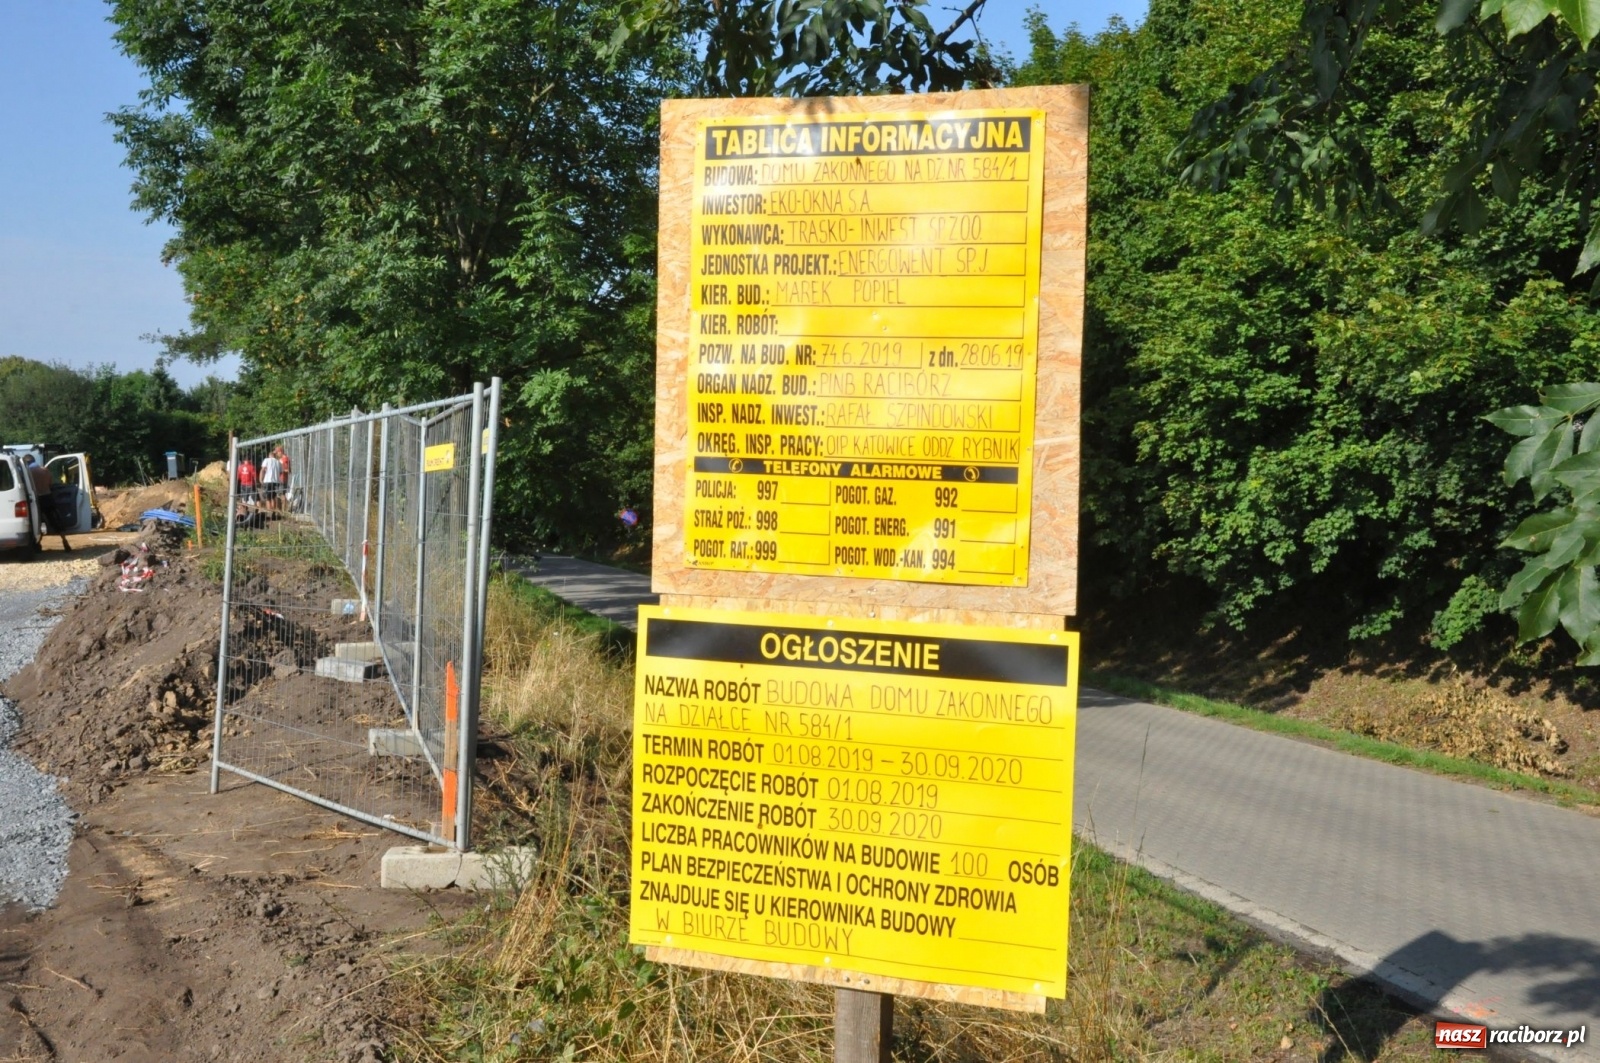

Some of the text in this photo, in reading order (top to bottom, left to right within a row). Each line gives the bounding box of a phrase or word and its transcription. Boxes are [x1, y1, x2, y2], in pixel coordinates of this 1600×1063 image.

[712, 121, 1024, 156] TABLICA INFORMACYJNA
[704, 165, 758, 187] BUDOWA:
[761, 162, 805, 183] DOMU
[813, 159, 896, 183] ZAKONNEGO
[904, 159, 923, 181] NA
[948, 158, 967, 180] NR
[972, 155, 1018, 181] 584/1
[702, 193, 767, 216] INWESTOR:
[770, 189, 844, 214] EKO-OKNA
[702, 223, 784, 246] WYKONAWCA:
[701, 254, 768, 276] JEDNOSTKA
[773, 254, 837, 276] PROJEKT.:
[838, 247, 946, 275] ENERGOWENT
[701, 284, 732, 306] KIER.
[775, 280, 832, 304] MAREK
[853, 278, 906, 304] POPIEL
[700, 308, 779, 336] KIER. ROBÓT:
[699, 343, 735, 365] POZW.
[740, 344, 756, 365] NA
[760, 344, 789, 365] BUD.
[795, 344, 816, 366] NR:
[928, 350, 936, 368] z
[939, 345, 958, 368] dn.
[697, 372, 737, 395] ORGAN
[741, 373, 776, 395] NADZ.
[820, 372, 856, 395] PINB
[863, 369, 952, 396] RACIBÓRZ
[697, 402, 726, 424] INSP.
[731, 403, 766, 425] NADZ.
[826, 402, 876, 426] RAFAŁ
[886, 402, 992, 429] SZPINDOWSKI
[697, 432, 740, 457] OKRĘG.
[745, 433, 775, 455] INSP.
[780, 434, 824, 457] PRACY:
[826, 434, 849, 456] OIP
[853, 434, 916, 457] KATOWICE
[962, 436, 1019, 460] RYBNIK
[763, 460, 942, 480] TELEFONY ALARMOWE
[695, 479, 779, 501] POLICJA: 997
[835, 485, 958, 508] POGOT. GAZ. 992
[694, 505, 723, 529] STRAŻ
[756, 510, 778, 531] 998
[835, 515, 956, 539] POGOT. ENERG. 991
[694, 538, 726, 558] POGOT.
[755, 540, 777, 561] 999
[834, 546, 955, 570] POGOT. WOD.-KAN. 994
[760, 632, 940, 671] OGŁOSZENIE
[644, 674, 1053, 725] NAZWA ROBÓT BUDOWA DOMU ZAKONNEGO
[645, 702, 853, 741] NA DZIAŁCE NR 584/1
[642, 734, 703, 759] TERMIN
[708, 738, 765, 764] ROBÓT
[773, 742, 874, 772] 01.08.2019
[901, 751, 1023, 785] 30.09.2020
[642, 763, 938, 810] ROZPOCZĘCIE ROBÓT 01.08.2019
[641, 791, 942, 839] ZAKOŃCZENIE ROBÓT 30.09.2020
[642, 821, 1059, 887] LICZBA PRACOWNIKÓW NA BUDOWIE 100 OSÓB
[641, 851, 1018, 914] PLAN BEZPIECZEŃSTWA I OCHRONY ZDROWIA
[639, 880, 957, 939] ZNAJDUJE SIĘ U KIEROWNIKA BUDOWY
[656, 908, 854, 956] W BIURZE BUDOWY
